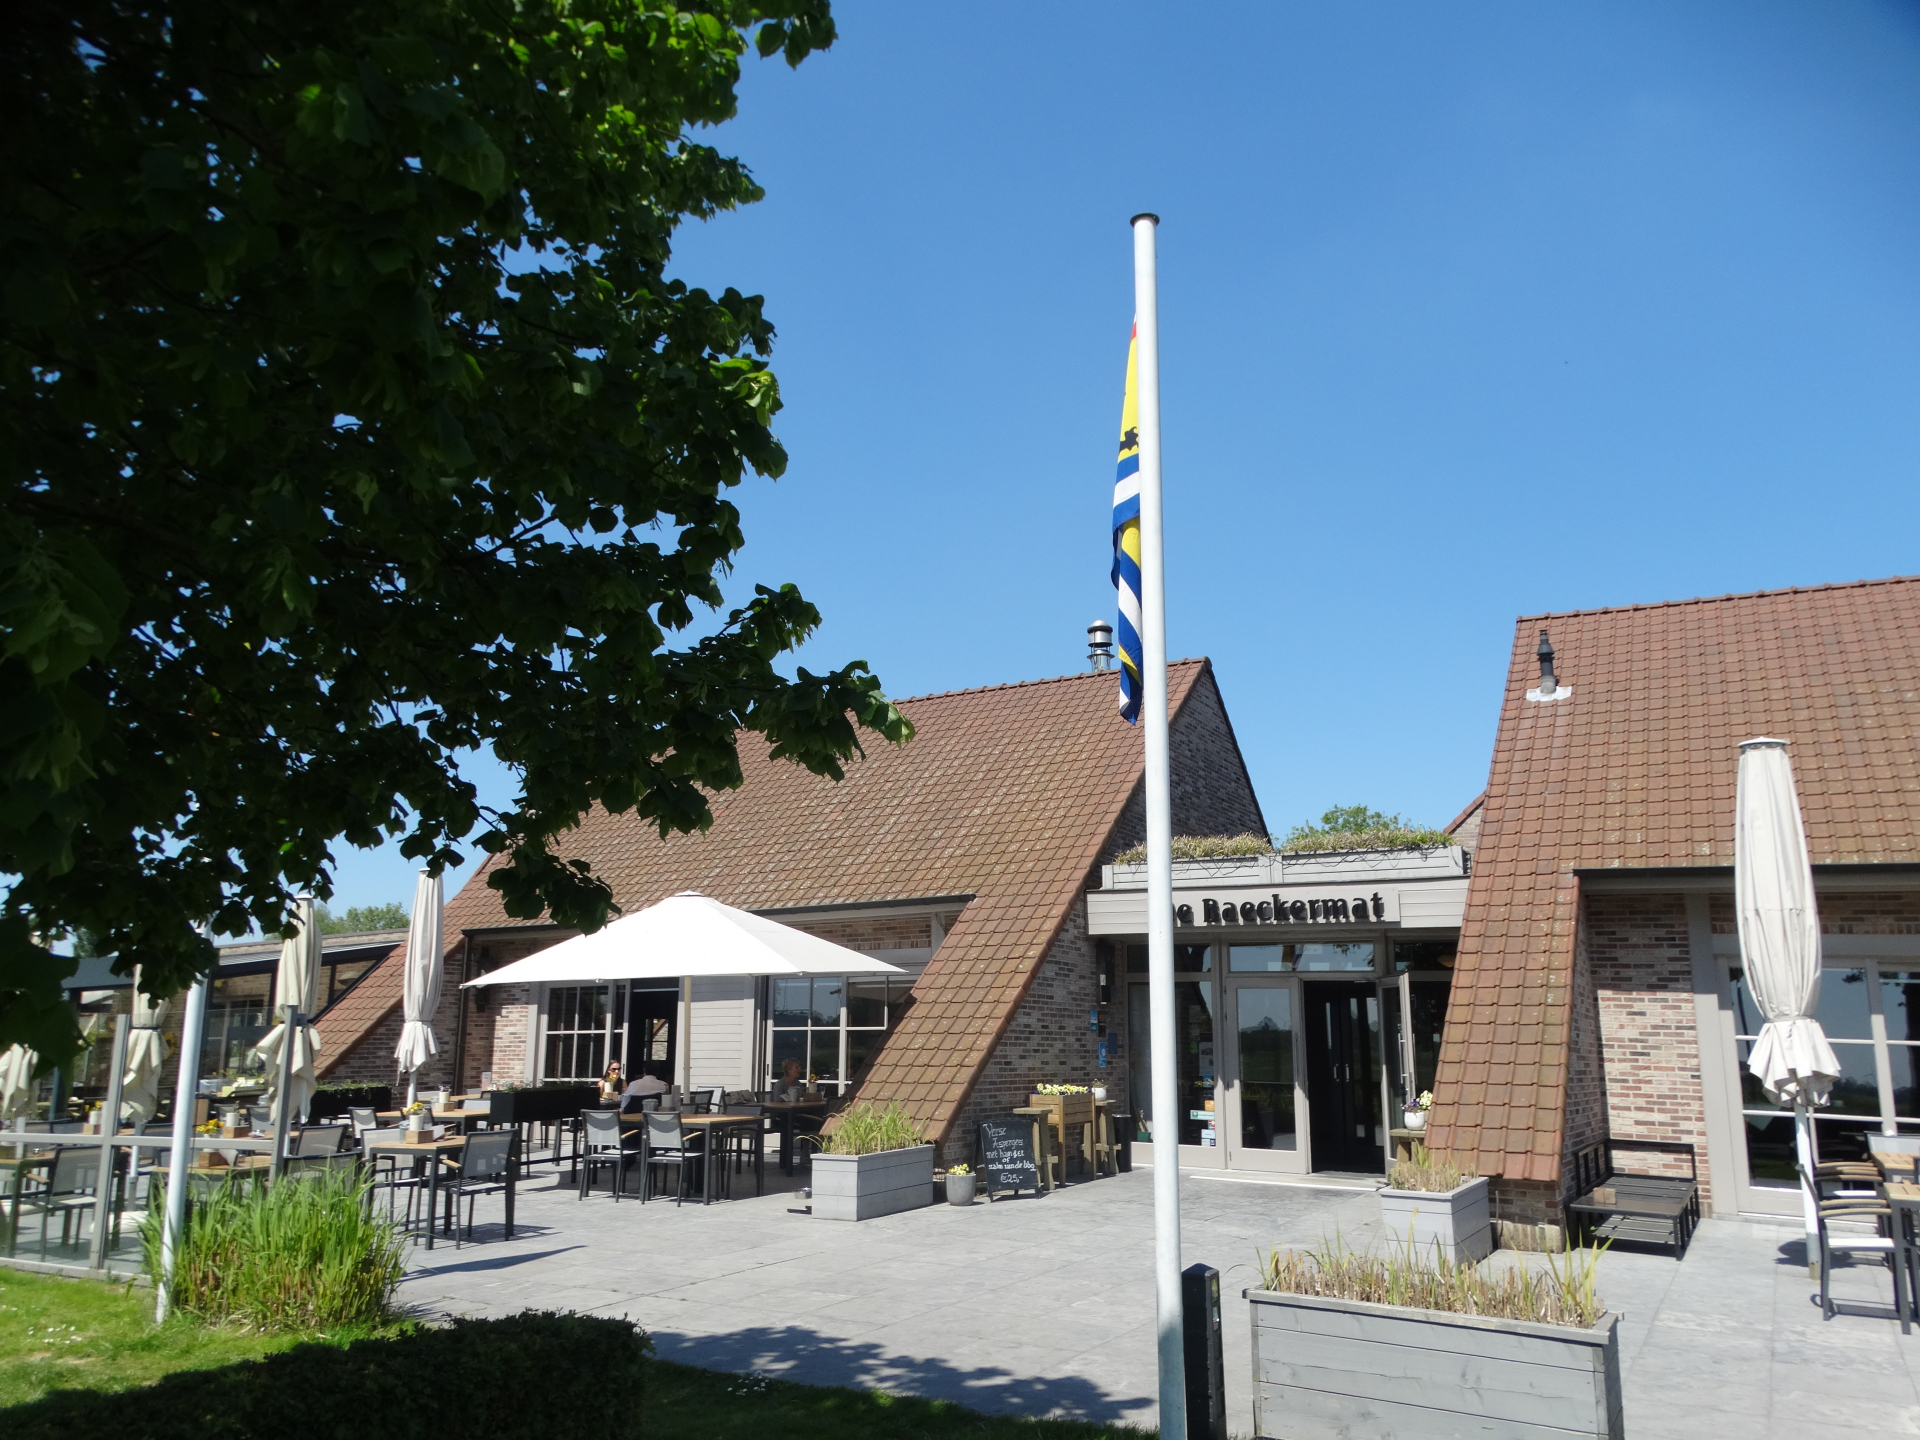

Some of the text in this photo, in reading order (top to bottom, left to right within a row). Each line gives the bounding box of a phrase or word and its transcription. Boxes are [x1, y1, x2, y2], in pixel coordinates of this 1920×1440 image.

[1172, 892, 1385, 924] e Baeckermat
[983, 1123, 1007, 1138] Verse
[992, 1137, 1024, 1150] Asperges
[986, 1150, 998, 1159] met
[1023, 1159, 1037, 1172] bbq
